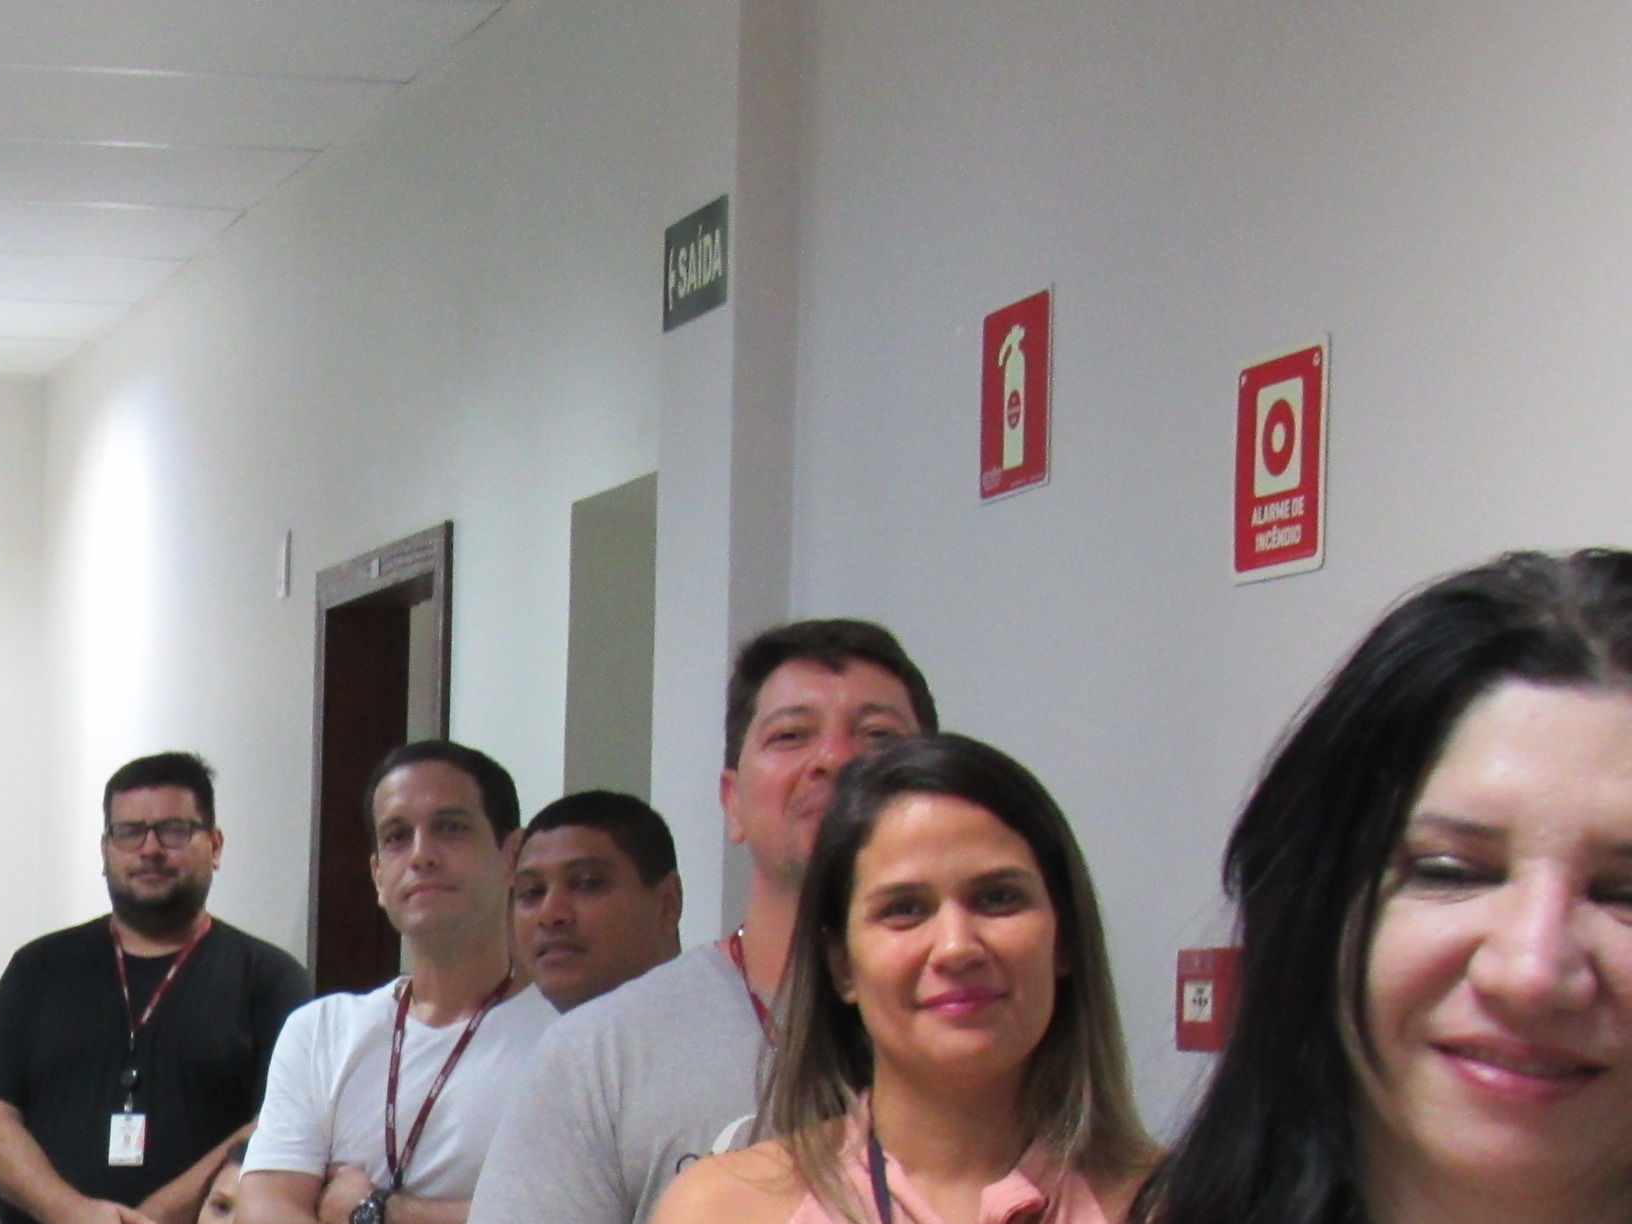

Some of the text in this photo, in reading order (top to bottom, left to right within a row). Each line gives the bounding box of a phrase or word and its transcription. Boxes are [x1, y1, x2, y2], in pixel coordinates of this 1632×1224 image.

[677, 224, 722, 299] SAÍDA
[1251, 495, 1305, 527] ALARME DE
[1255, 524, 1302, 553] INCÊNDIO
